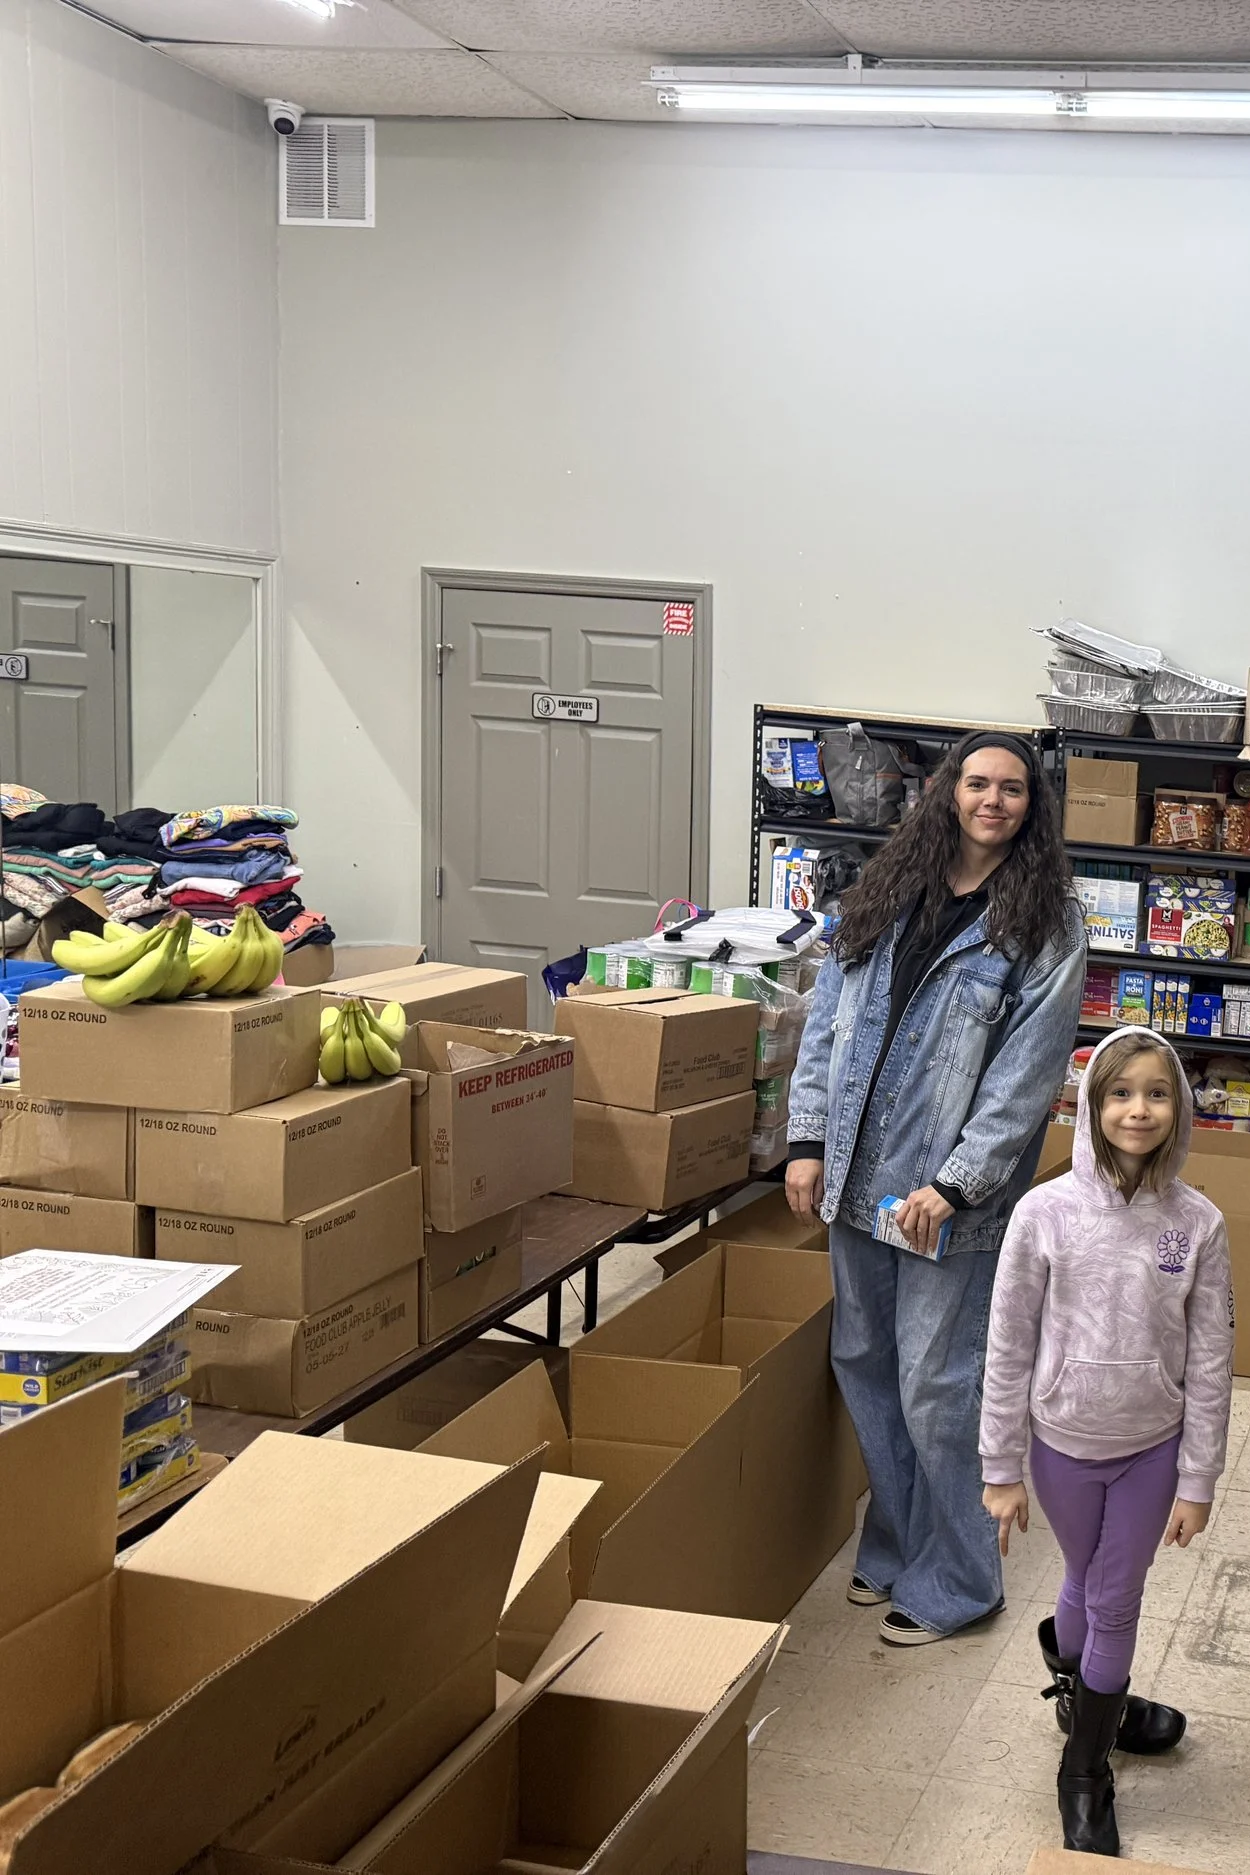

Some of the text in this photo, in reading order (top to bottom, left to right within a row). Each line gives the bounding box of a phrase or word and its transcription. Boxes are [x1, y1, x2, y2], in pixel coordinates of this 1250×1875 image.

[669, 609, 688, 617] FIRE
[558, 700, 593, 710] EMPLOYEES
[567, 709, 583, 717] ONLY
[1125, 976, 1144, 985] PASTA
[1125, 986, 1144, 995] RONI
[22, 1008, 107, 1024] 12/18 OZ ROUND
[234, 1012, 283, 1033] 12/18 OZ ROUND
[458, 1050, 574, 1099] KEEP REFRIGERATED
[16, 1101, 64, 1116] OZ ROUND
[491, 1096, 524, 1114] BETWEEN
[139, 1118, 217, 1137] 12/18 OZ ROUND
[288, 1115, 342, 1142] 12/18 OZ ROUND
[21, 1201, 35, 1212] OZ
[36, 1202, 71, 1215] ROUND
[158, 1217, 235, 1236] 12/18 OZ ROUND
[304, 1210, 356, 1240] 12/18 OZ ROUND
[195, 1320, 231, 1335] ROUND
[302, 1304, 354, 1339] 12/18 OZ ROUND
